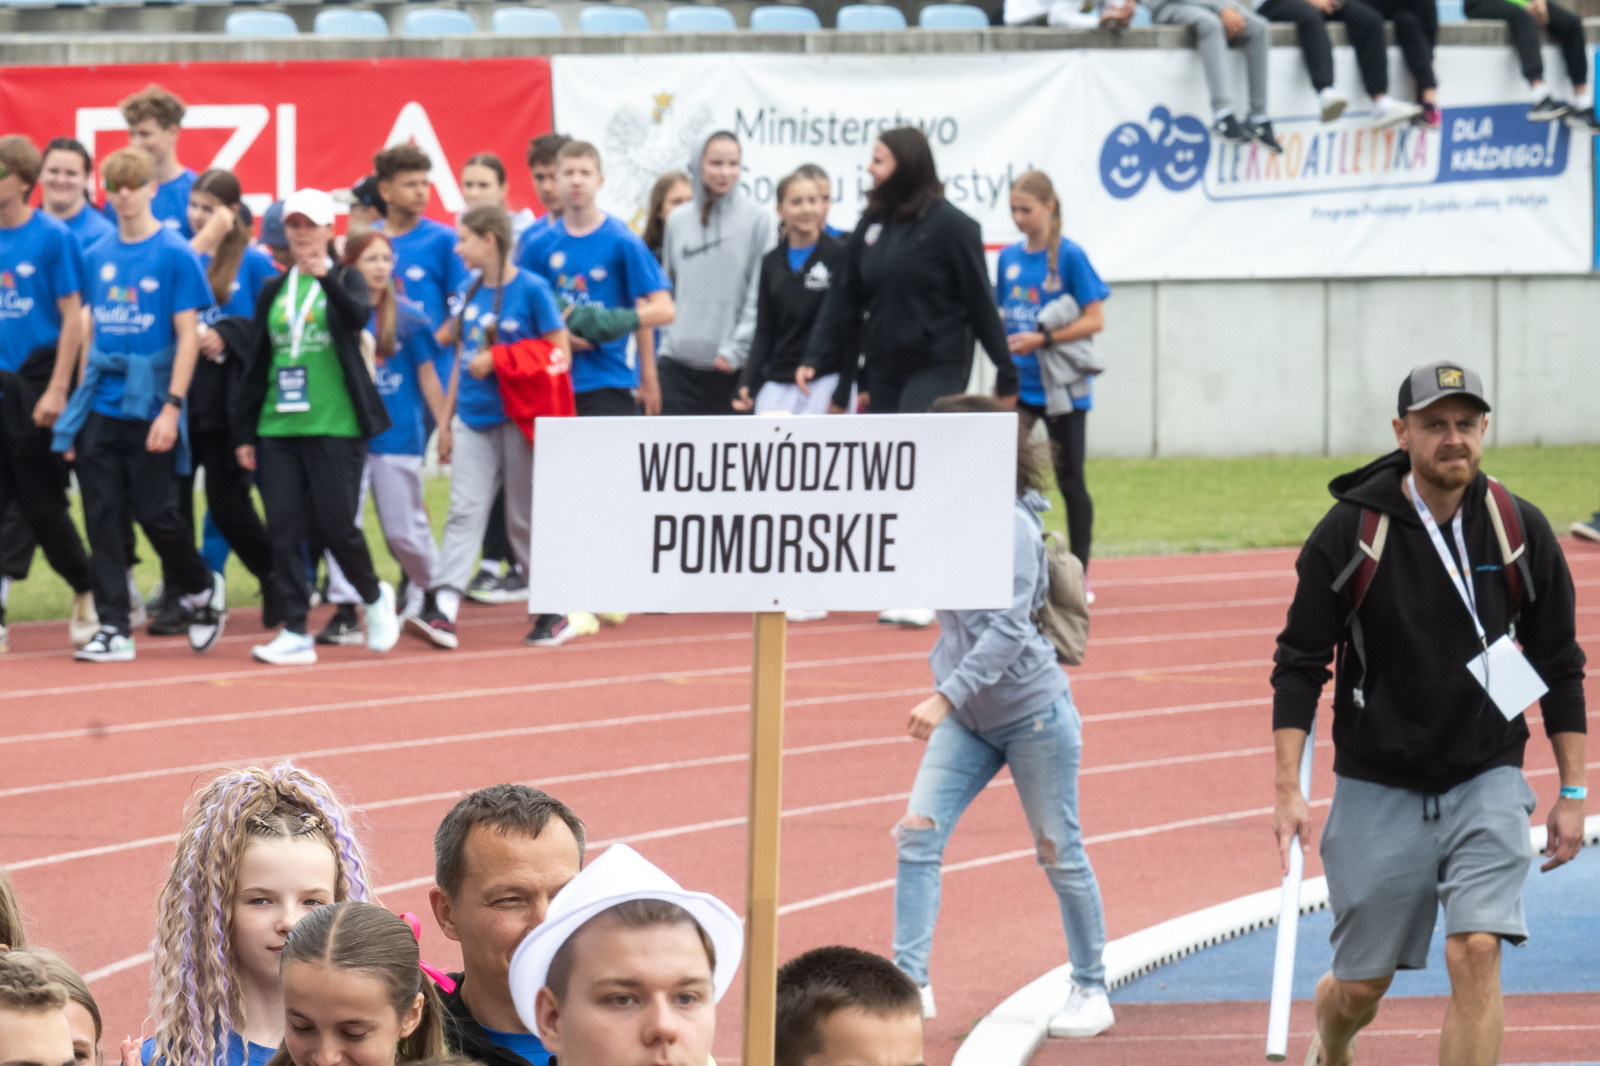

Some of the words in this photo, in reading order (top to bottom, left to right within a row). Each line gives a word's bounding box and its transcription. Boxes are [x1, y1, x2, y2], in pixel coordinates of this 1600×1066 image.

[1452, 116, 1493, 141] DLA
[638, 433, 916, 492] WOJEWÓDZTWO
[651, 512, 899, 574] POMORSKIE
